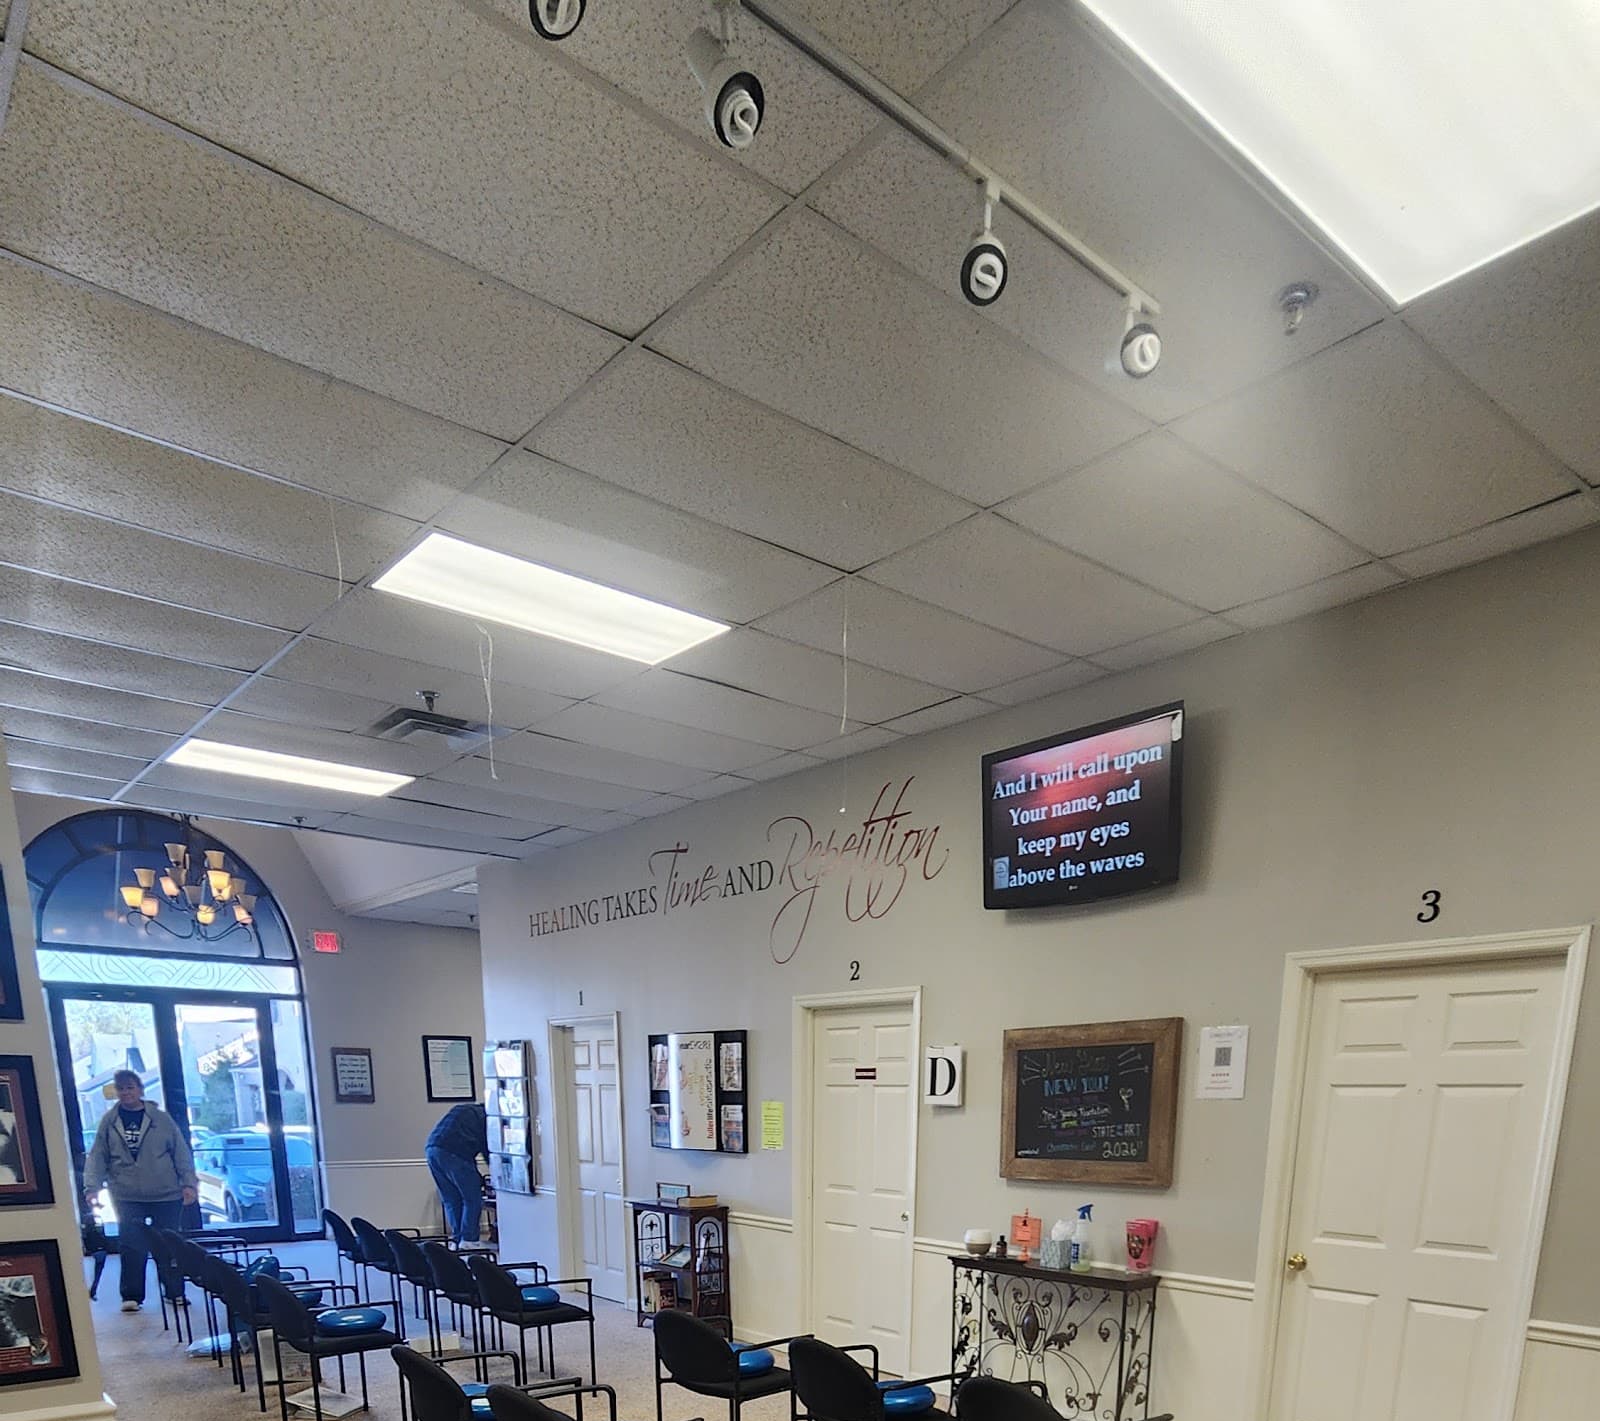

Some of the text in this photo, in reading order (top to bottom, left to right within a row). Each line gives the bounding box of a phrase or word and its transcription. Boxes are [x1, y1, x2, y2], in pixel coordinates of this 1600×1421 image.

[992, 744, 1163, 800] And I will call upon
[1009, 779, 1141, 827] Your name, and
[1017, 821, 1130, 857] keep my eyes
[529, 775, 951, 965] HEALING TAKES Time AND Repetition
[1008, 851, 1145, 888] above the waves
[1416, 889, 1441, 923] 3
[849, 960, 861, 981] 2
[578, 990, 584, 1006] 1
[926, 1056, 957, 1096] D
[1043, 1074, 1110, 1097] NEW YOU!
